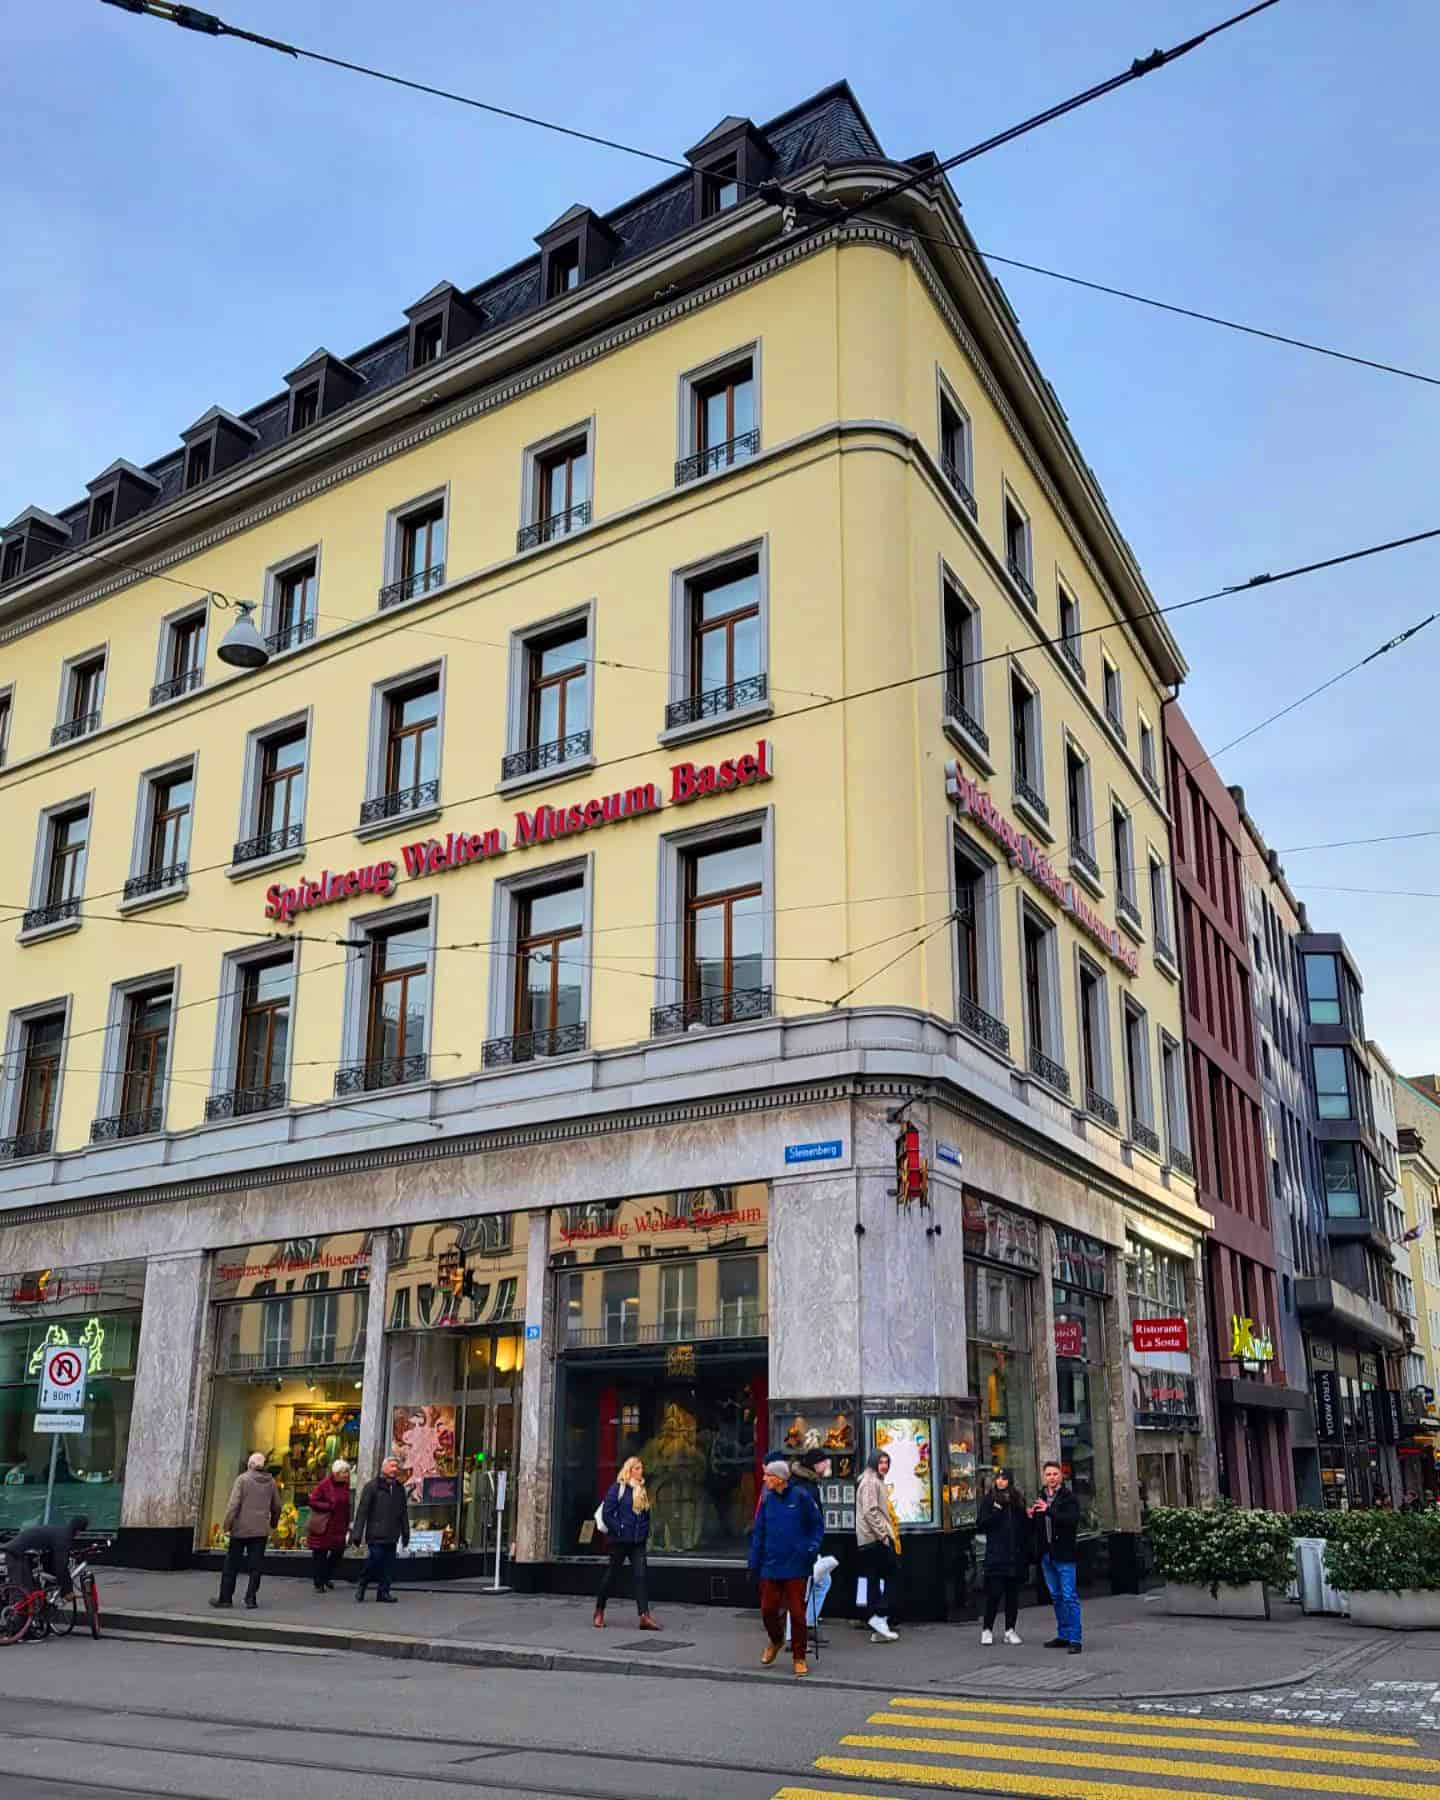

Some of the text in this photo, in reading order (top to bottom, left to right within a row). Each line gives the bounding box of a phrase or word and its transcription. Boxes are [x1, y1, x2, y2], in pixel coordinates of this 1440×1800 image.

[265, 738, 774, 926] Spielzeug Welten Museum Basel
[1135, 1323, 1184, 1334] Ristorante
[1140, 1338, 1153, 1348] La
[1321, 1374, 1331, 1402] VERO
[1324, 1403, 1335, 1436] MODA
